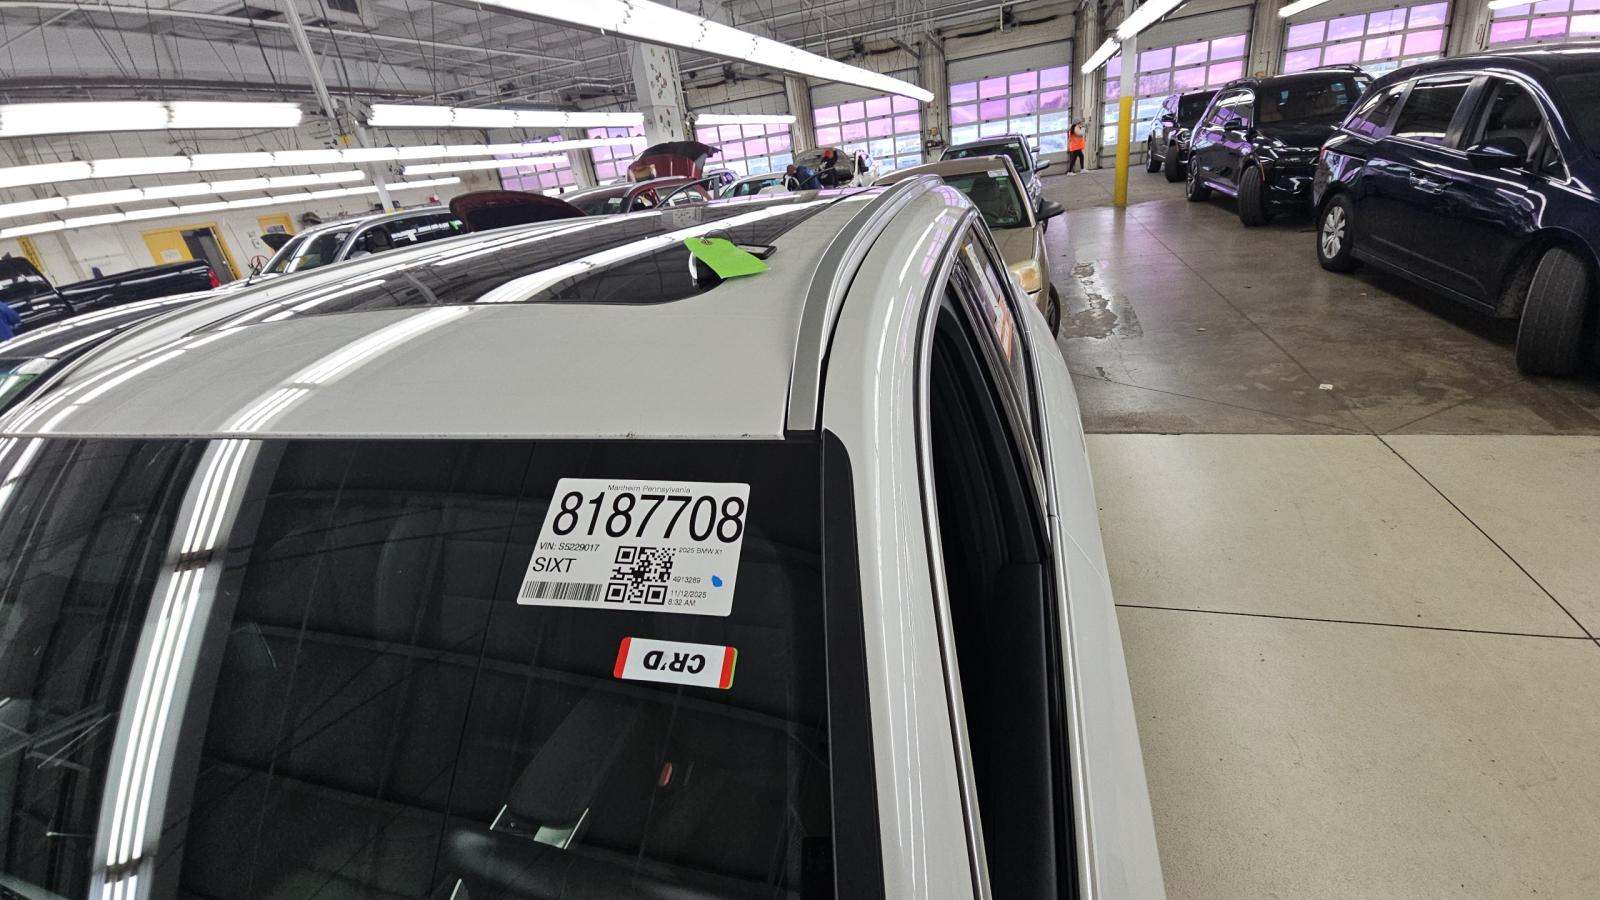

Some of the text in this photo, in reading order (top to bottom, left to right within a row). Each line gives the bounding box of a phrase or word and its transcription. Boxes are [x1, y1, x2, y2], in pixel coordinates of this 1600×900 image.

[643, 486, 691, 494] Pennsylvania
[552, 491, 745, 543] 8187708
[540, 542, 600, 551] VIN: S5229017
[532, 557, 577, 573] SIXT
[670, 590, 707, 598] 11/12/2025
